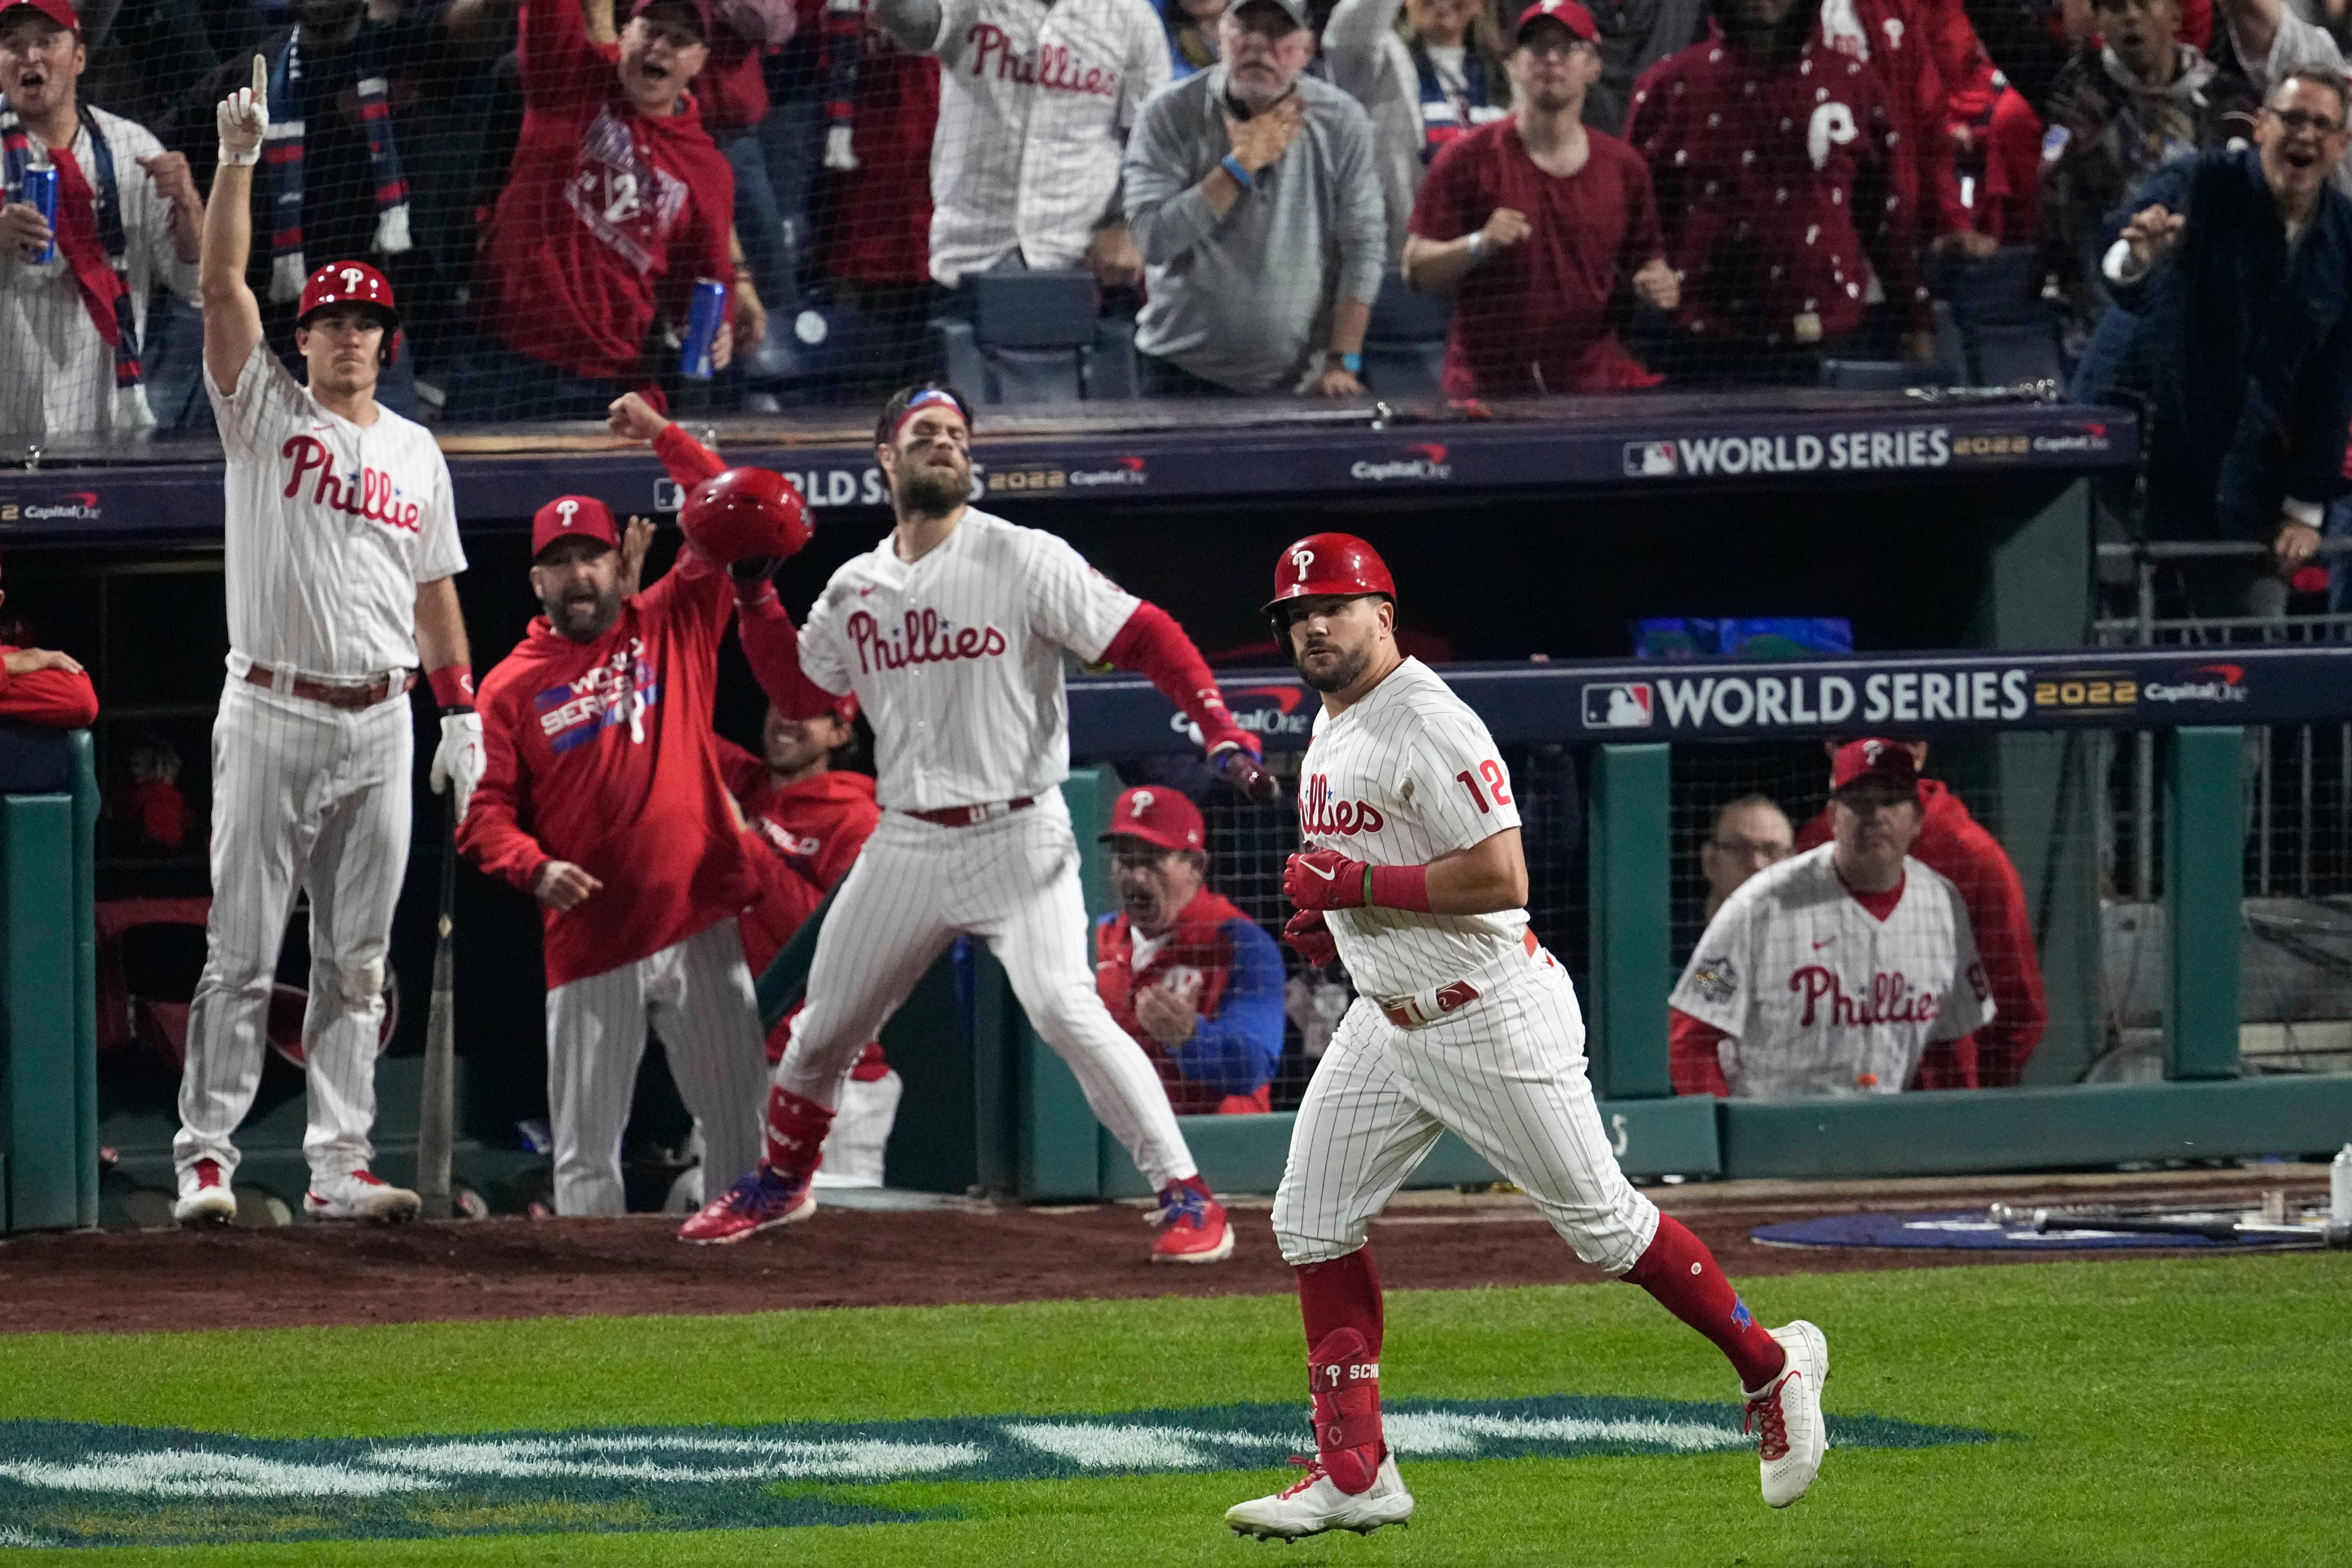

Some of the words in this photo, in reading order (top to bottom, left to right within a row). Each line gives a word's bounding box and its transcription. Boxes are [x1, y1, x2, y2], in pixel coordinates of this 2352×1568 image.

[340, 268, 365, 293] P
[1681, 435, 1824, 475] WORLD
[1829, 428, 1949, 469] SERIES
[283, 435, 421, 533] Phillie
[988, 469, 1066, 490] 2022
[556, 500, 579, 527] P
[1293, 551, 1314, 581] P
[848, 609, 1006, 674] Phillies
[1657, 677, 1855, 728] WORLD
[1864, 669, 2028, 722] SERIES
[2034, 681, 2138, 705] 2022
[1863, 740, 1883, 766] P
[1457, 760, 1511, 814] 12
[1132, 791, 1154, 817] P
[1790, 966, 1938, 1026] Phillie
[1326, 1365, 1341, 1386] P
